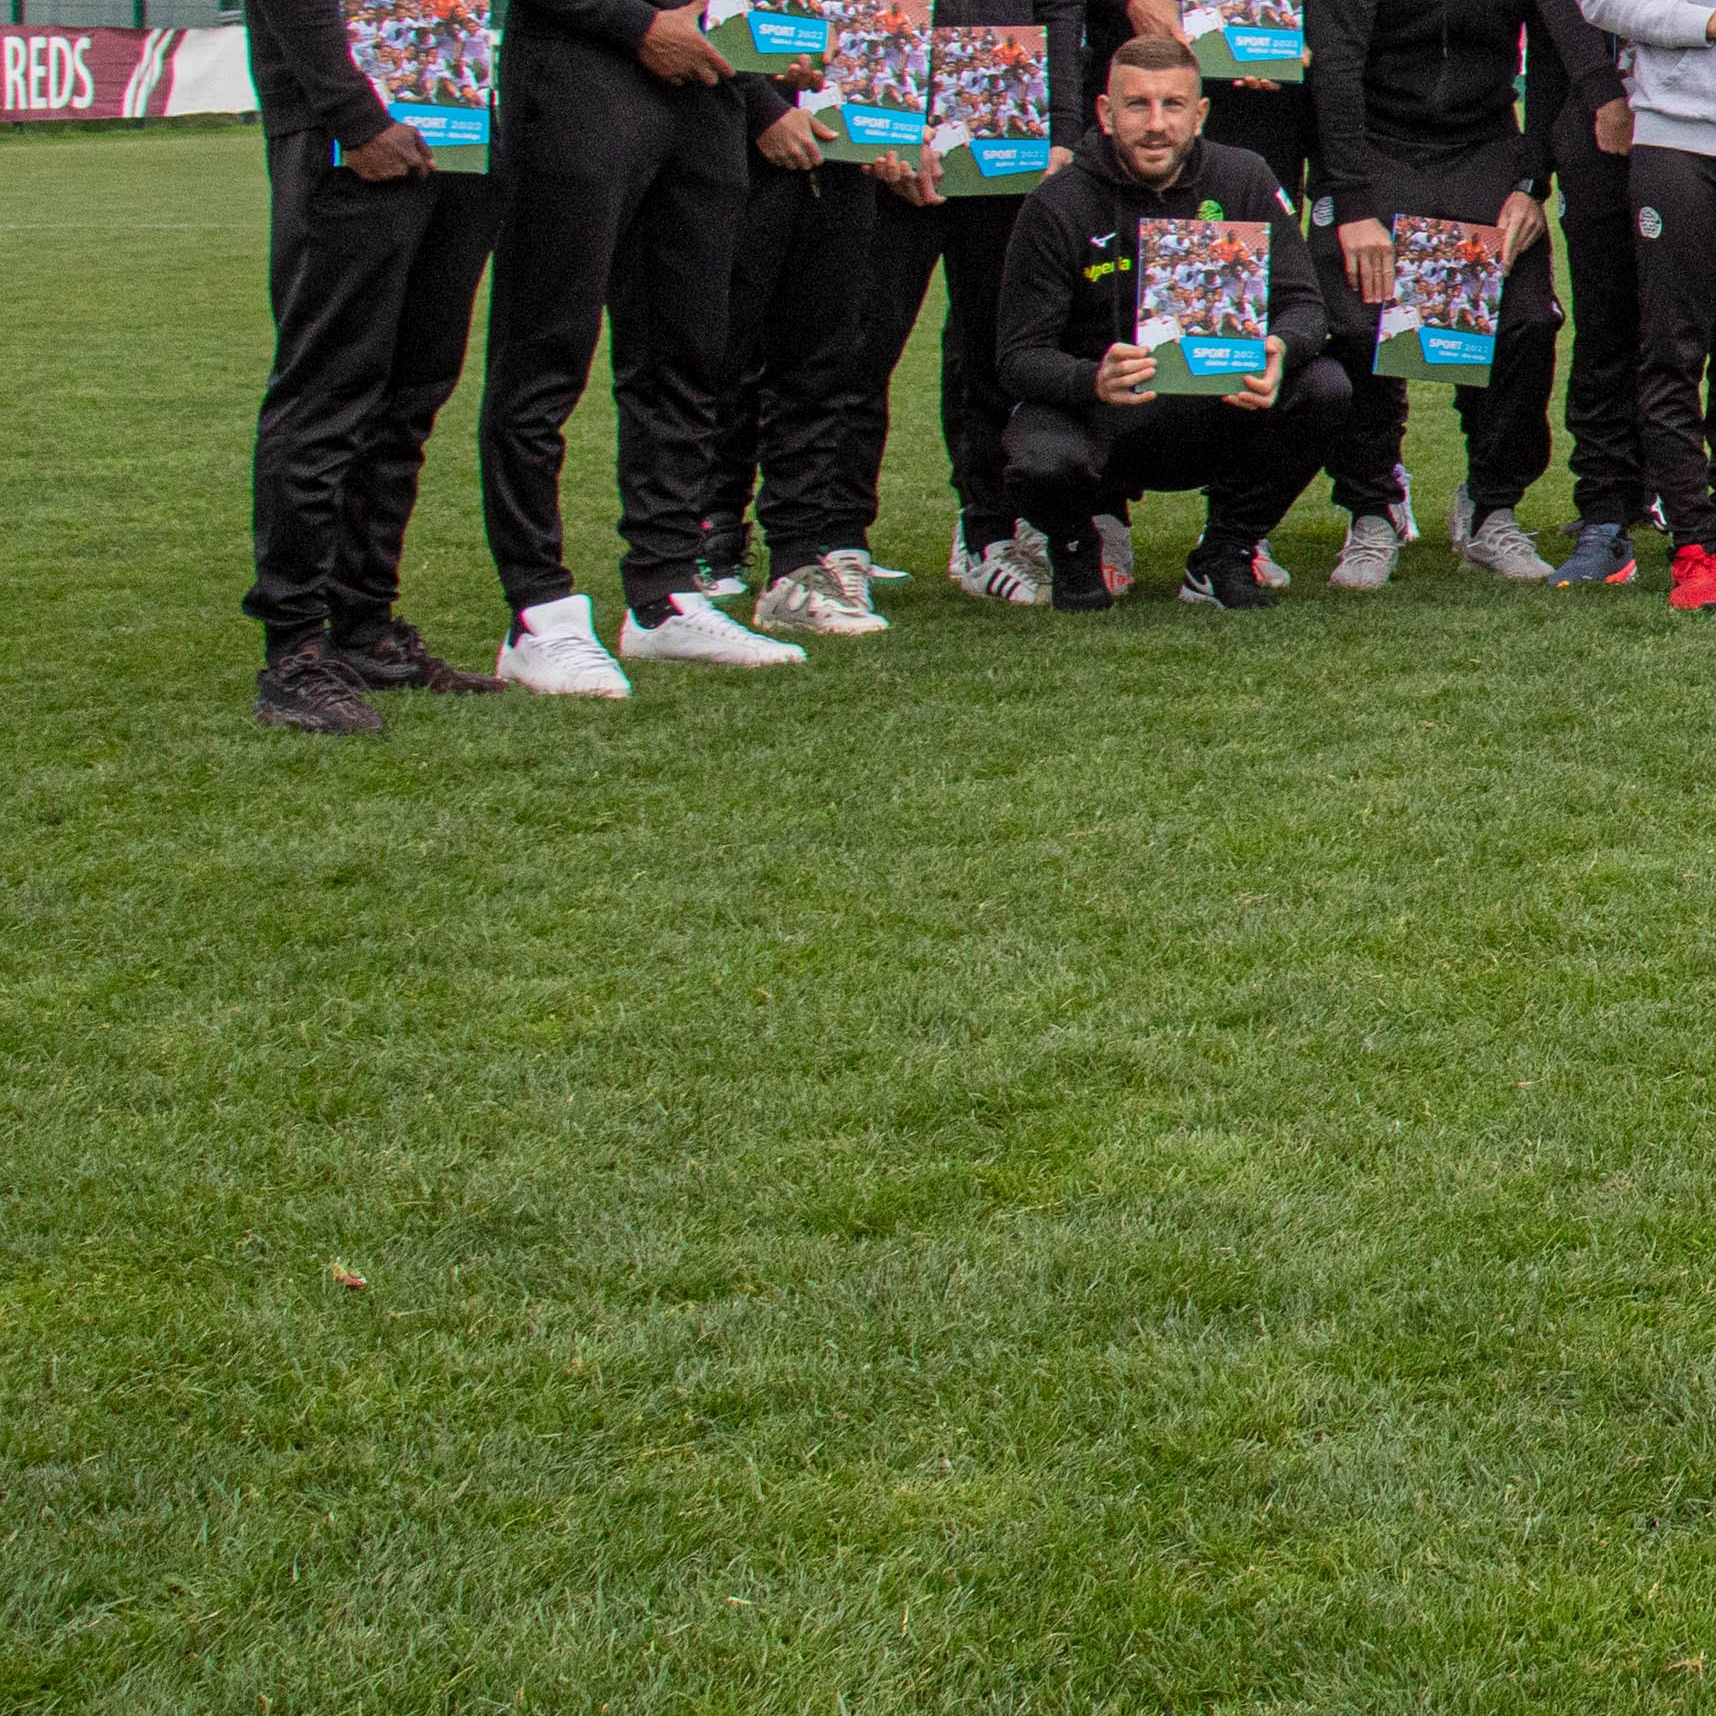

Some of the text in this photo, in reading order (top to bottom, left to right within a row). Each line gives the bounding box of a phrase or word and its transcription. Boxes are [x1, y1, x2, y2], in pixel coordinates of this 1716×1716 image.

[759, 23, 796, 37] SPORT
[1235, 35, 1271, 48] SPORT
[2, 35, 96, 111] REDS
[853, 115, 891, 130] SPORT
[983, 150, 1018, 161] SPORT
[1429, 337, 1463, 351] SPORT
[1193, 347, 1232, 359] SPORT
